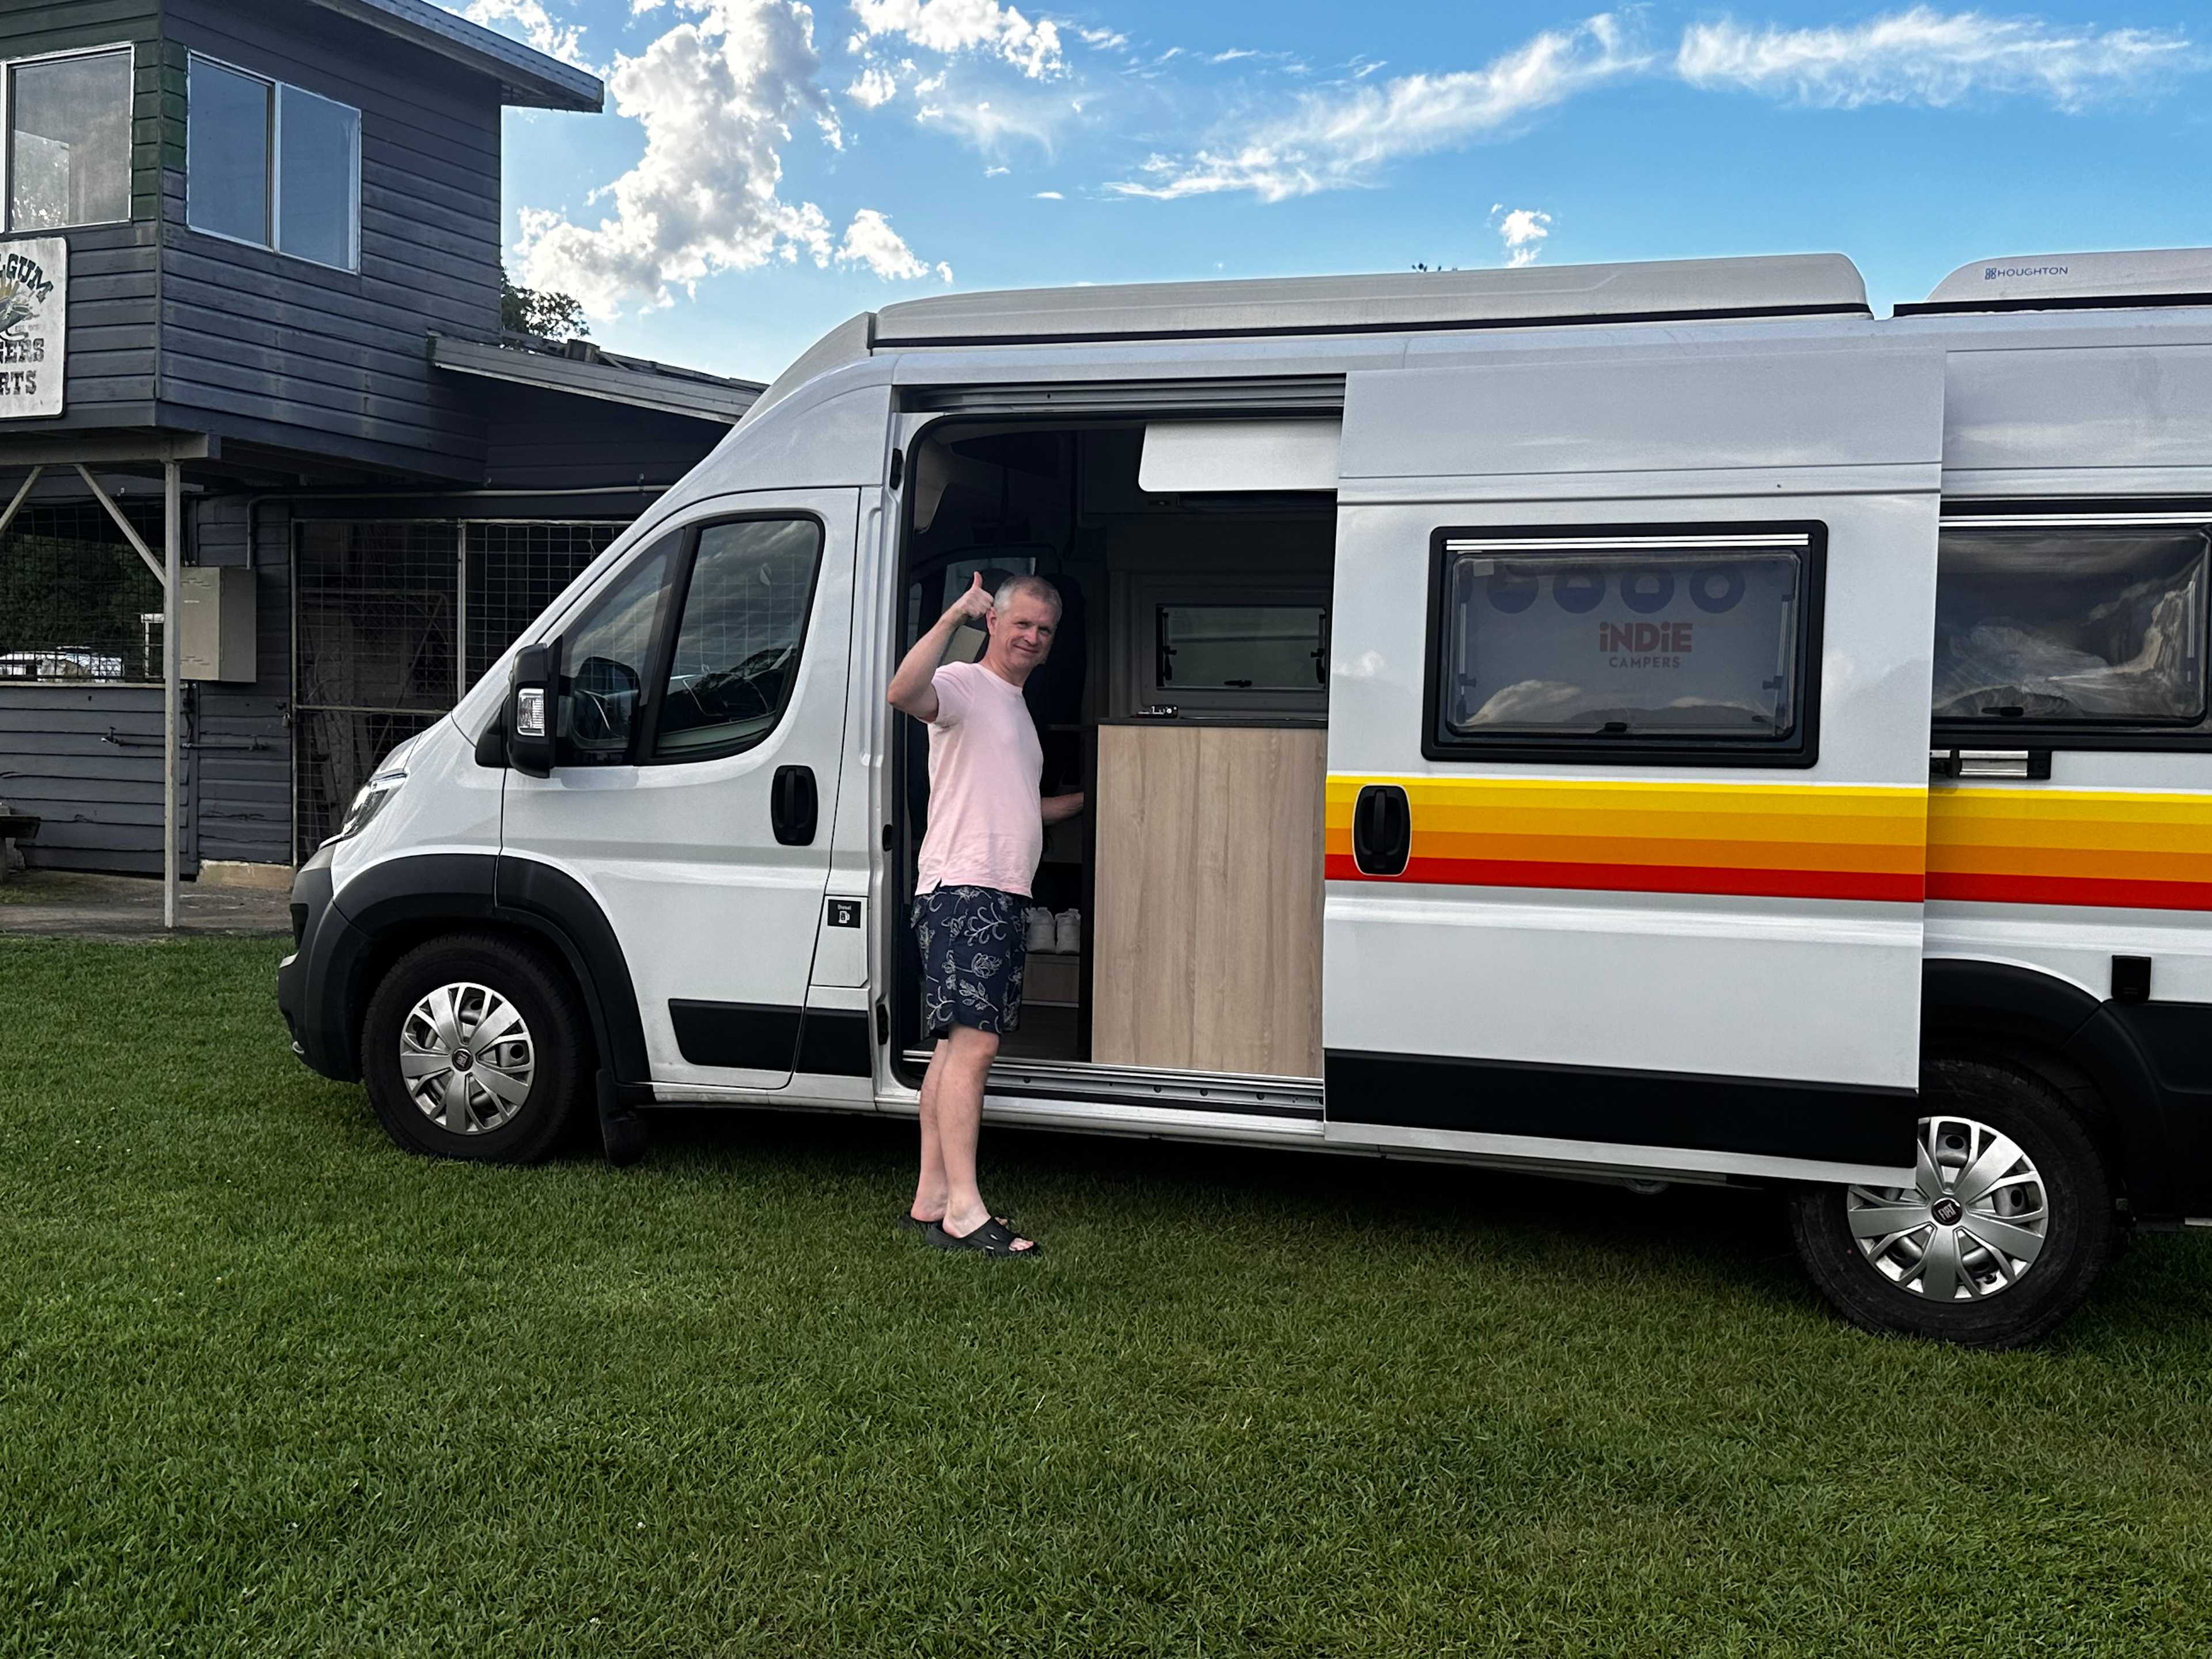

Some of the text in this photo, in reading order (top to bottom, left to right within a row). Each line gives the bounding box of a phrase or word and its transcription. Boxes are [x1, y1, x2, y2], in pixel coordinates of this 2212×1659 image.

[1998, 267, 2068, 276] HOUGHTON
[1609, 656, 1680, 669] CAMPERS
[1937, 1203, 1956, 1220] FIAT
